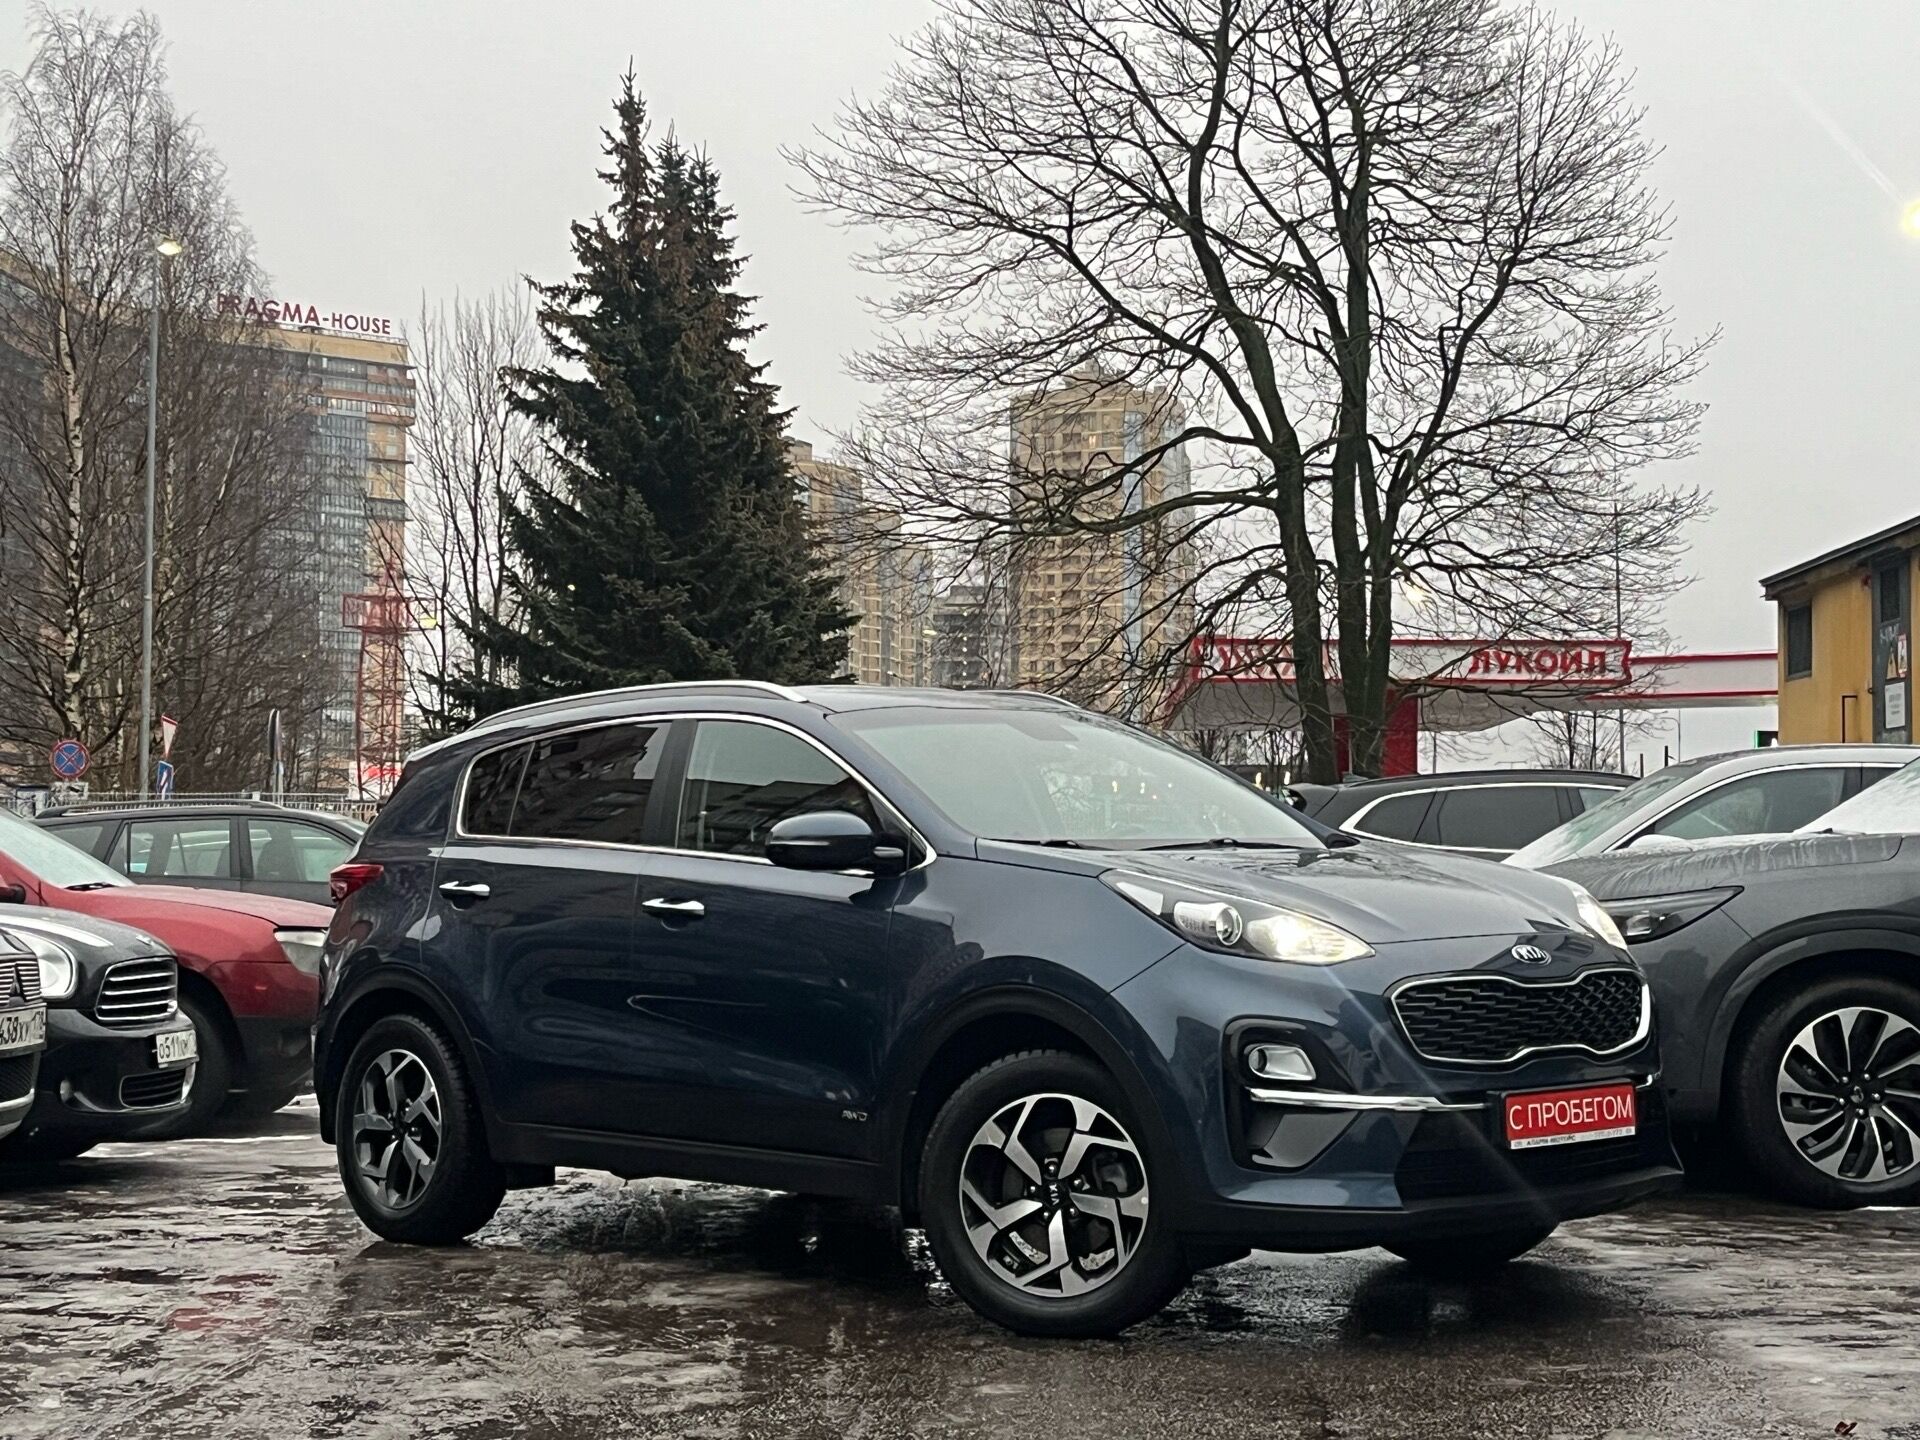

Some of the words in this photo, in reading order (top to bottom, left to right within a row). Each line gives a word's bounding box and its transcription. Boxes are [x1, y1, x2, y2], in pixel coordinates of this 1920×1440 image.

[217, 293, 391, 335] PRAGMA-HOUSE
[1509, 1105, 1523, 1130] С
[1528, 1094, 1632, 1128] ПРОБЕГОМ
